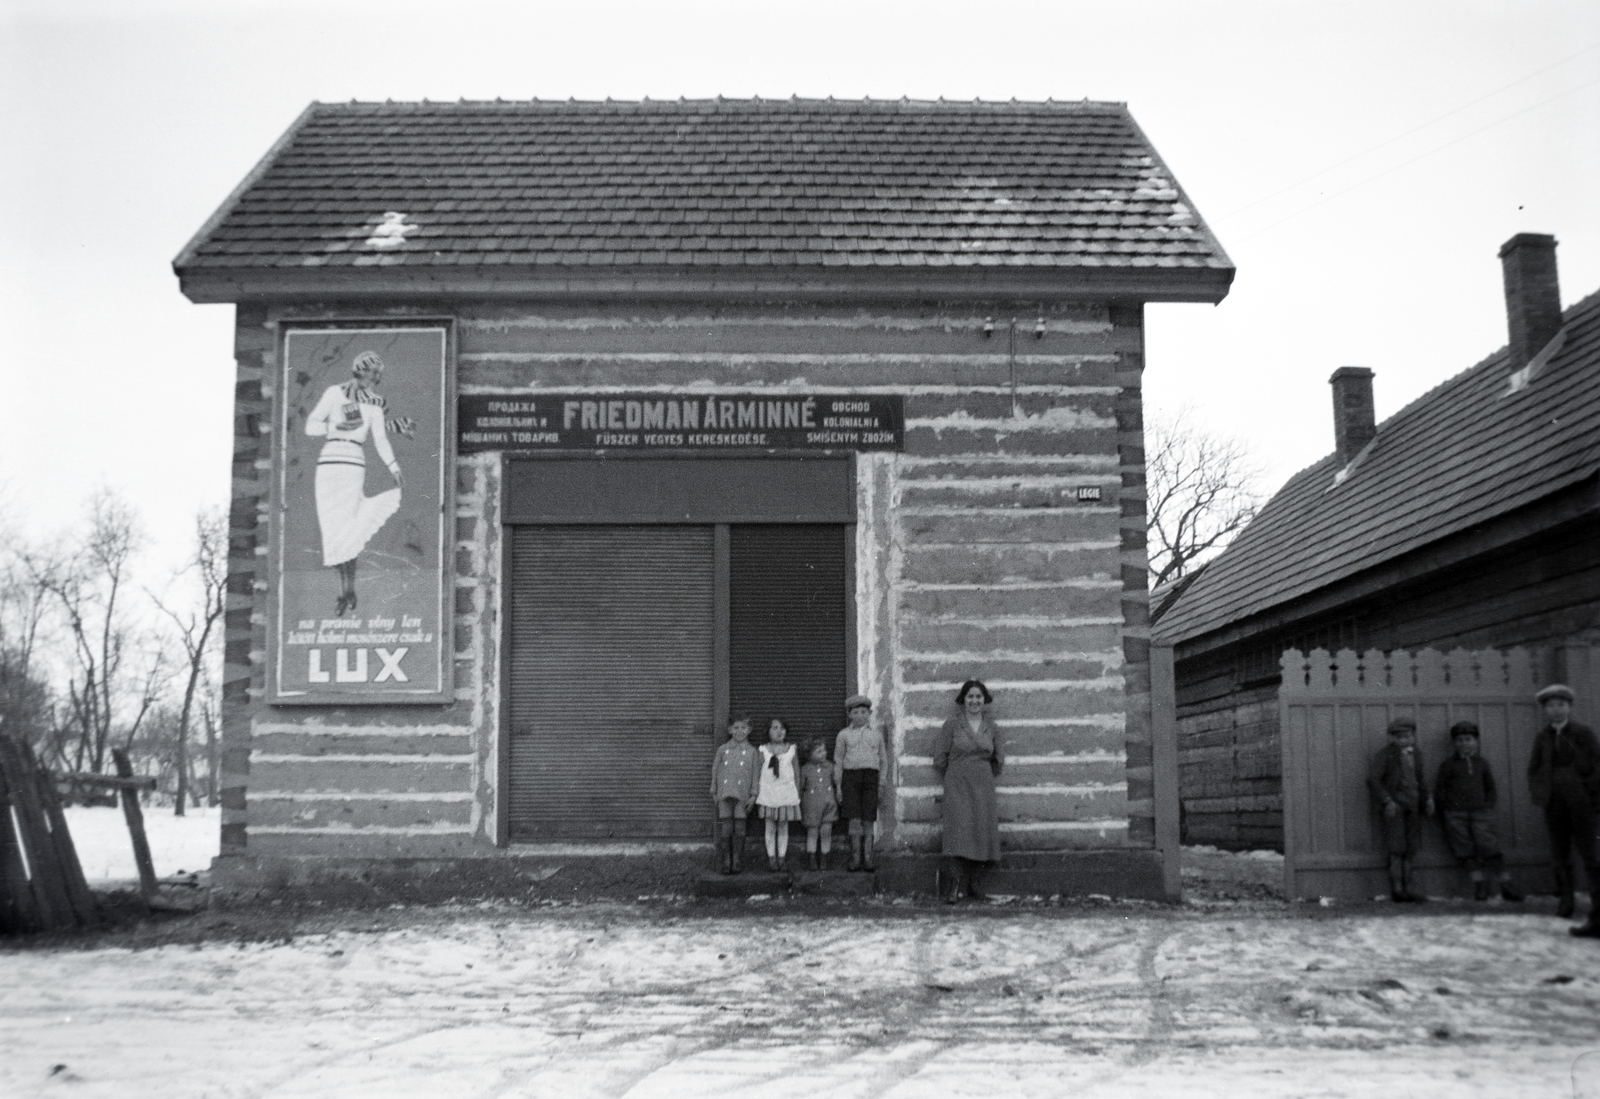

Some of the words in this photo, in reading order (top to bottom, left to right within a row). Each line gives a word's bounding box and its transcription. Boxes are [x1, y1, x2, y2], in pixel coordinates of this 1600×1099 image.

[488, 401, 536, 413] ПРОДАЖА
[563, 400, 699, 430] FRIEDMAN
[703, 396, 816, 430] ÁRMINNÉ
[832, 401, 870, 412] OBCHOD
[596, 432, 638, 445] FÜSZER
[644, 433, 683, 445] VEGYES
[1079, 488, 1100, 499] LEGIE
[298, 619, 315, 629] na
[320, 614, 362, 632] pranie
[368, 614, 395, 631] vlny
[401, 614, 422, 628] len
[399, 628, 424, 643] csak
[424, 633, 433, 643] a
[308, 647, 409, 683] LUX
